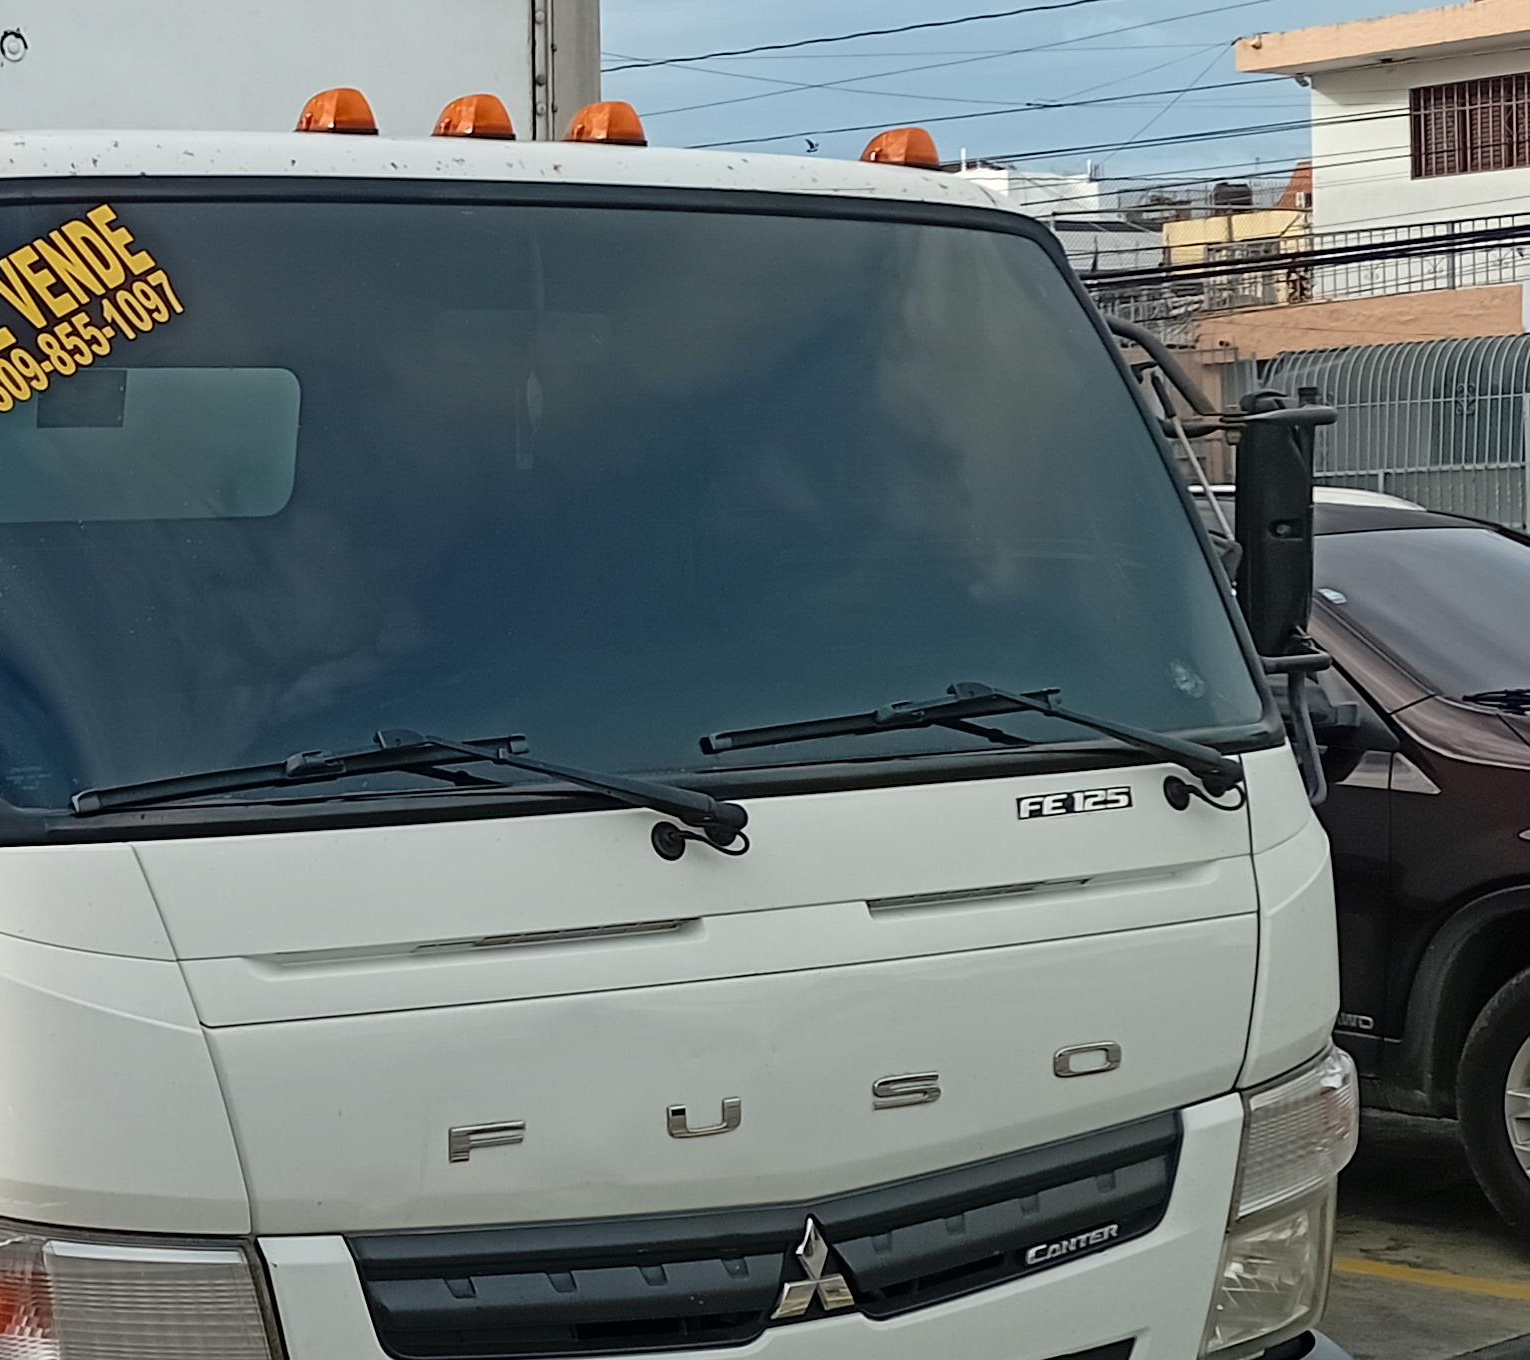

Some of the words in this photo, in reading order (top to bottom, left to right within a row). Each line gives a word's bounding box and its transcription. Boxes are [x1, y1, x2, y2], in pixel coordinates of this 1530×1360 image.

[1019, 794, 1068, 819] FE
[1072, 787, 1131, 812] 125
[448, 1040, 1122, 1163] FUSO
[1026, 1224, 1119, 1265] CANTER
